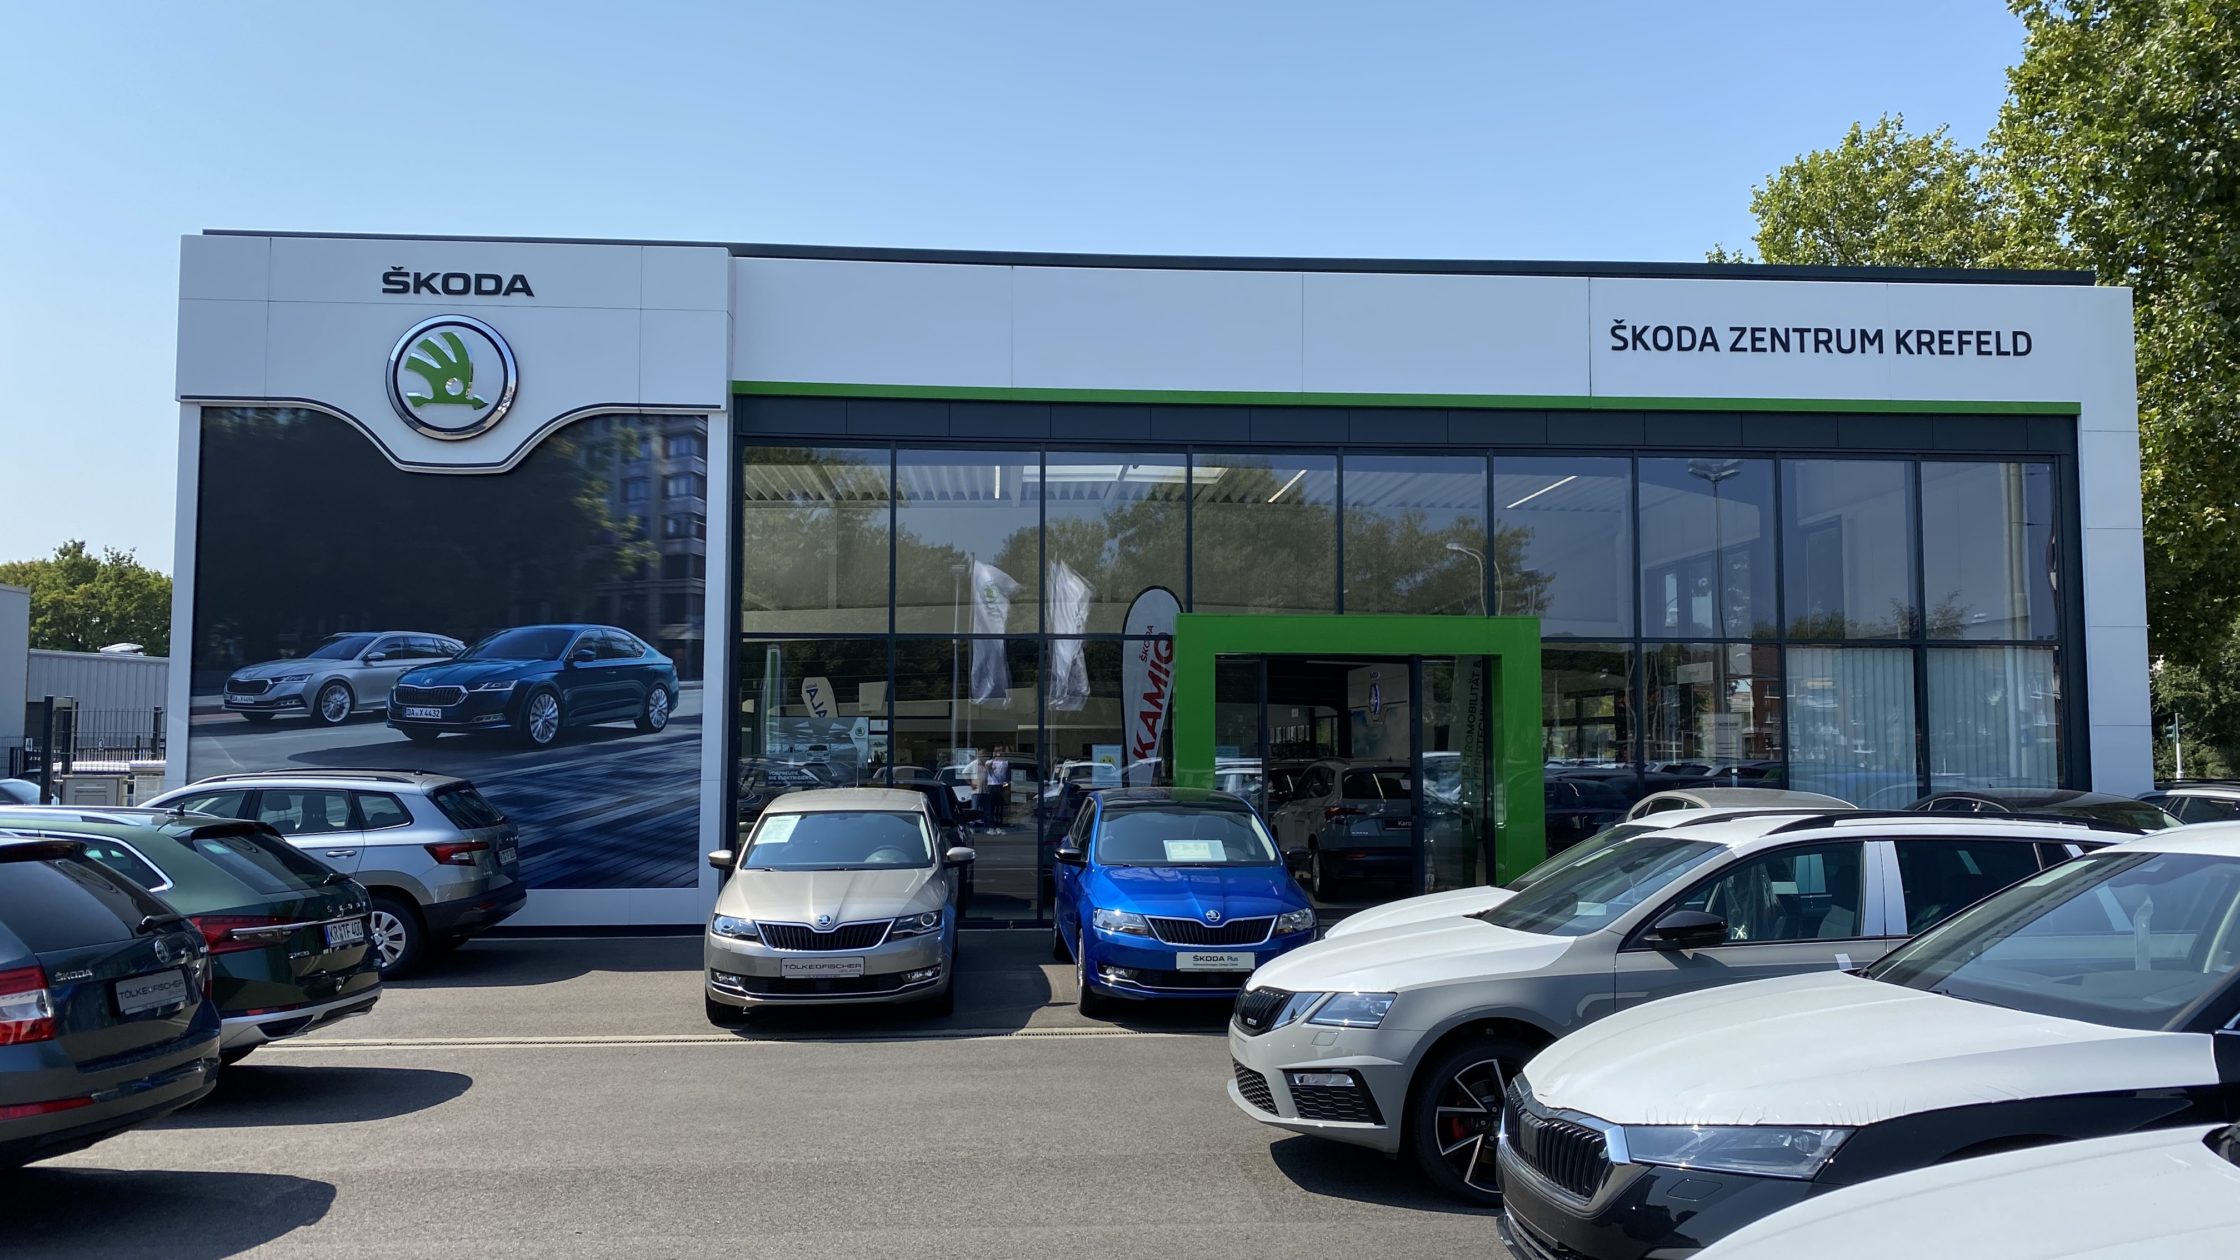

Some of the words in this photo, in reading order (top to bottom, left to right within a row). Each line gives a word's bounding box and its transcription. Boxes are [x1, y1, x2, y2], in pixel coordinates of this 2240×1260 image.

[382, 266, 534, 297] ŠKODA
[1610, 319, 1720, 352] ŠKODA
[1729, 327, 1884, 354] ZENTRUM
[1895, 329, 2033, 356] KREFELD
[1133, 632, 1174, 760] KAMIQ
[1193, 954, 1225, 962] ŠKODA
